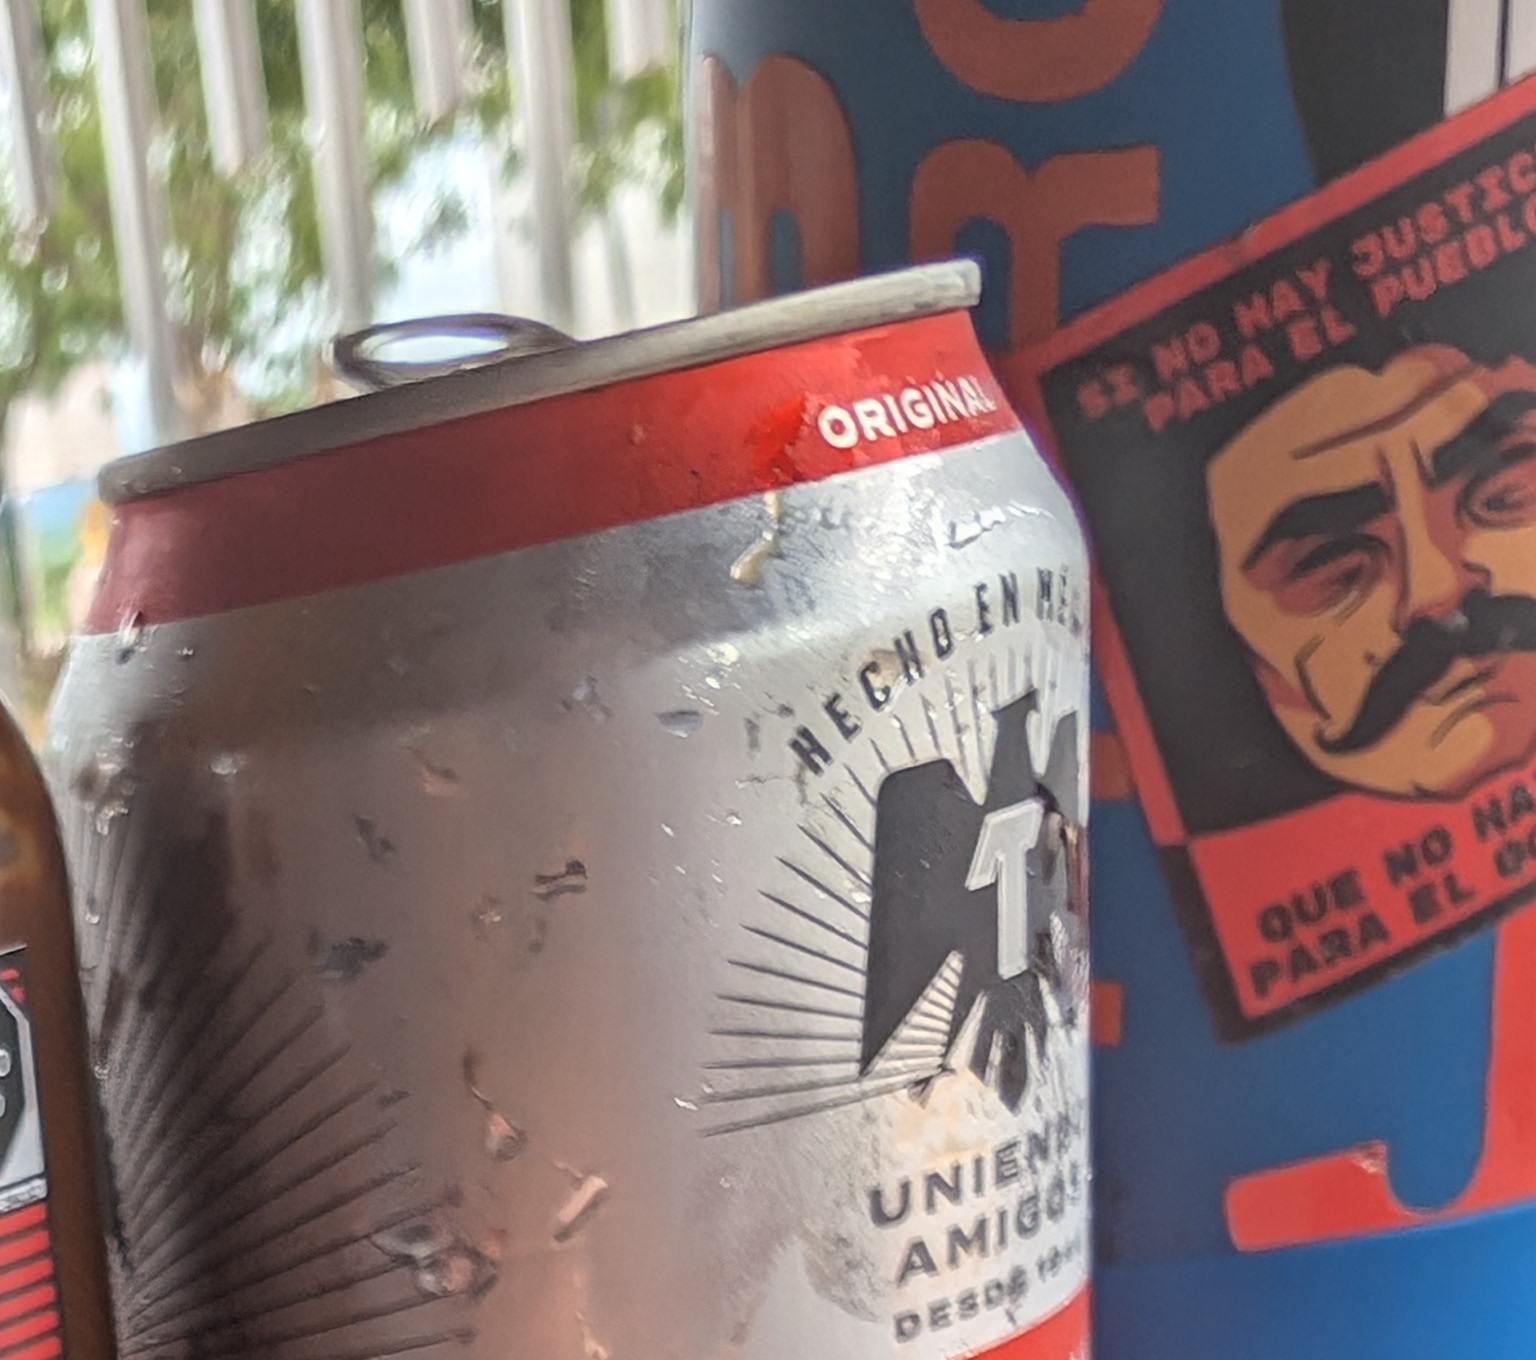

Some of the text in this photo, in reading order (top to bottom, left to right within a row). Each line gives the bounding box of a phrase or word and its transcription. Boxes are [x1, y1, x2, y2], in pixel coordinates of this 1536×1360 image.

[1152, 322, 1220, 382] NO
[1234, 258, 1330, 338] HAY
[1350, 142, 1536, 278] JUSTIC
[818, 375, 997, 449] ORIGINAL
[1144, 345, 1273, 432] PARA
[1287, 303, 1358, 361] EL
[788, 607, 955, 777] HECHO
[974, 571, 1020, 634] EN
[1257, 869, 1363, 943] QUE
[1383, 824, 1453, 886] NO
[1471, 768, 1536, 842] HA
[1250, 872, 1477, 999] PARA EL
